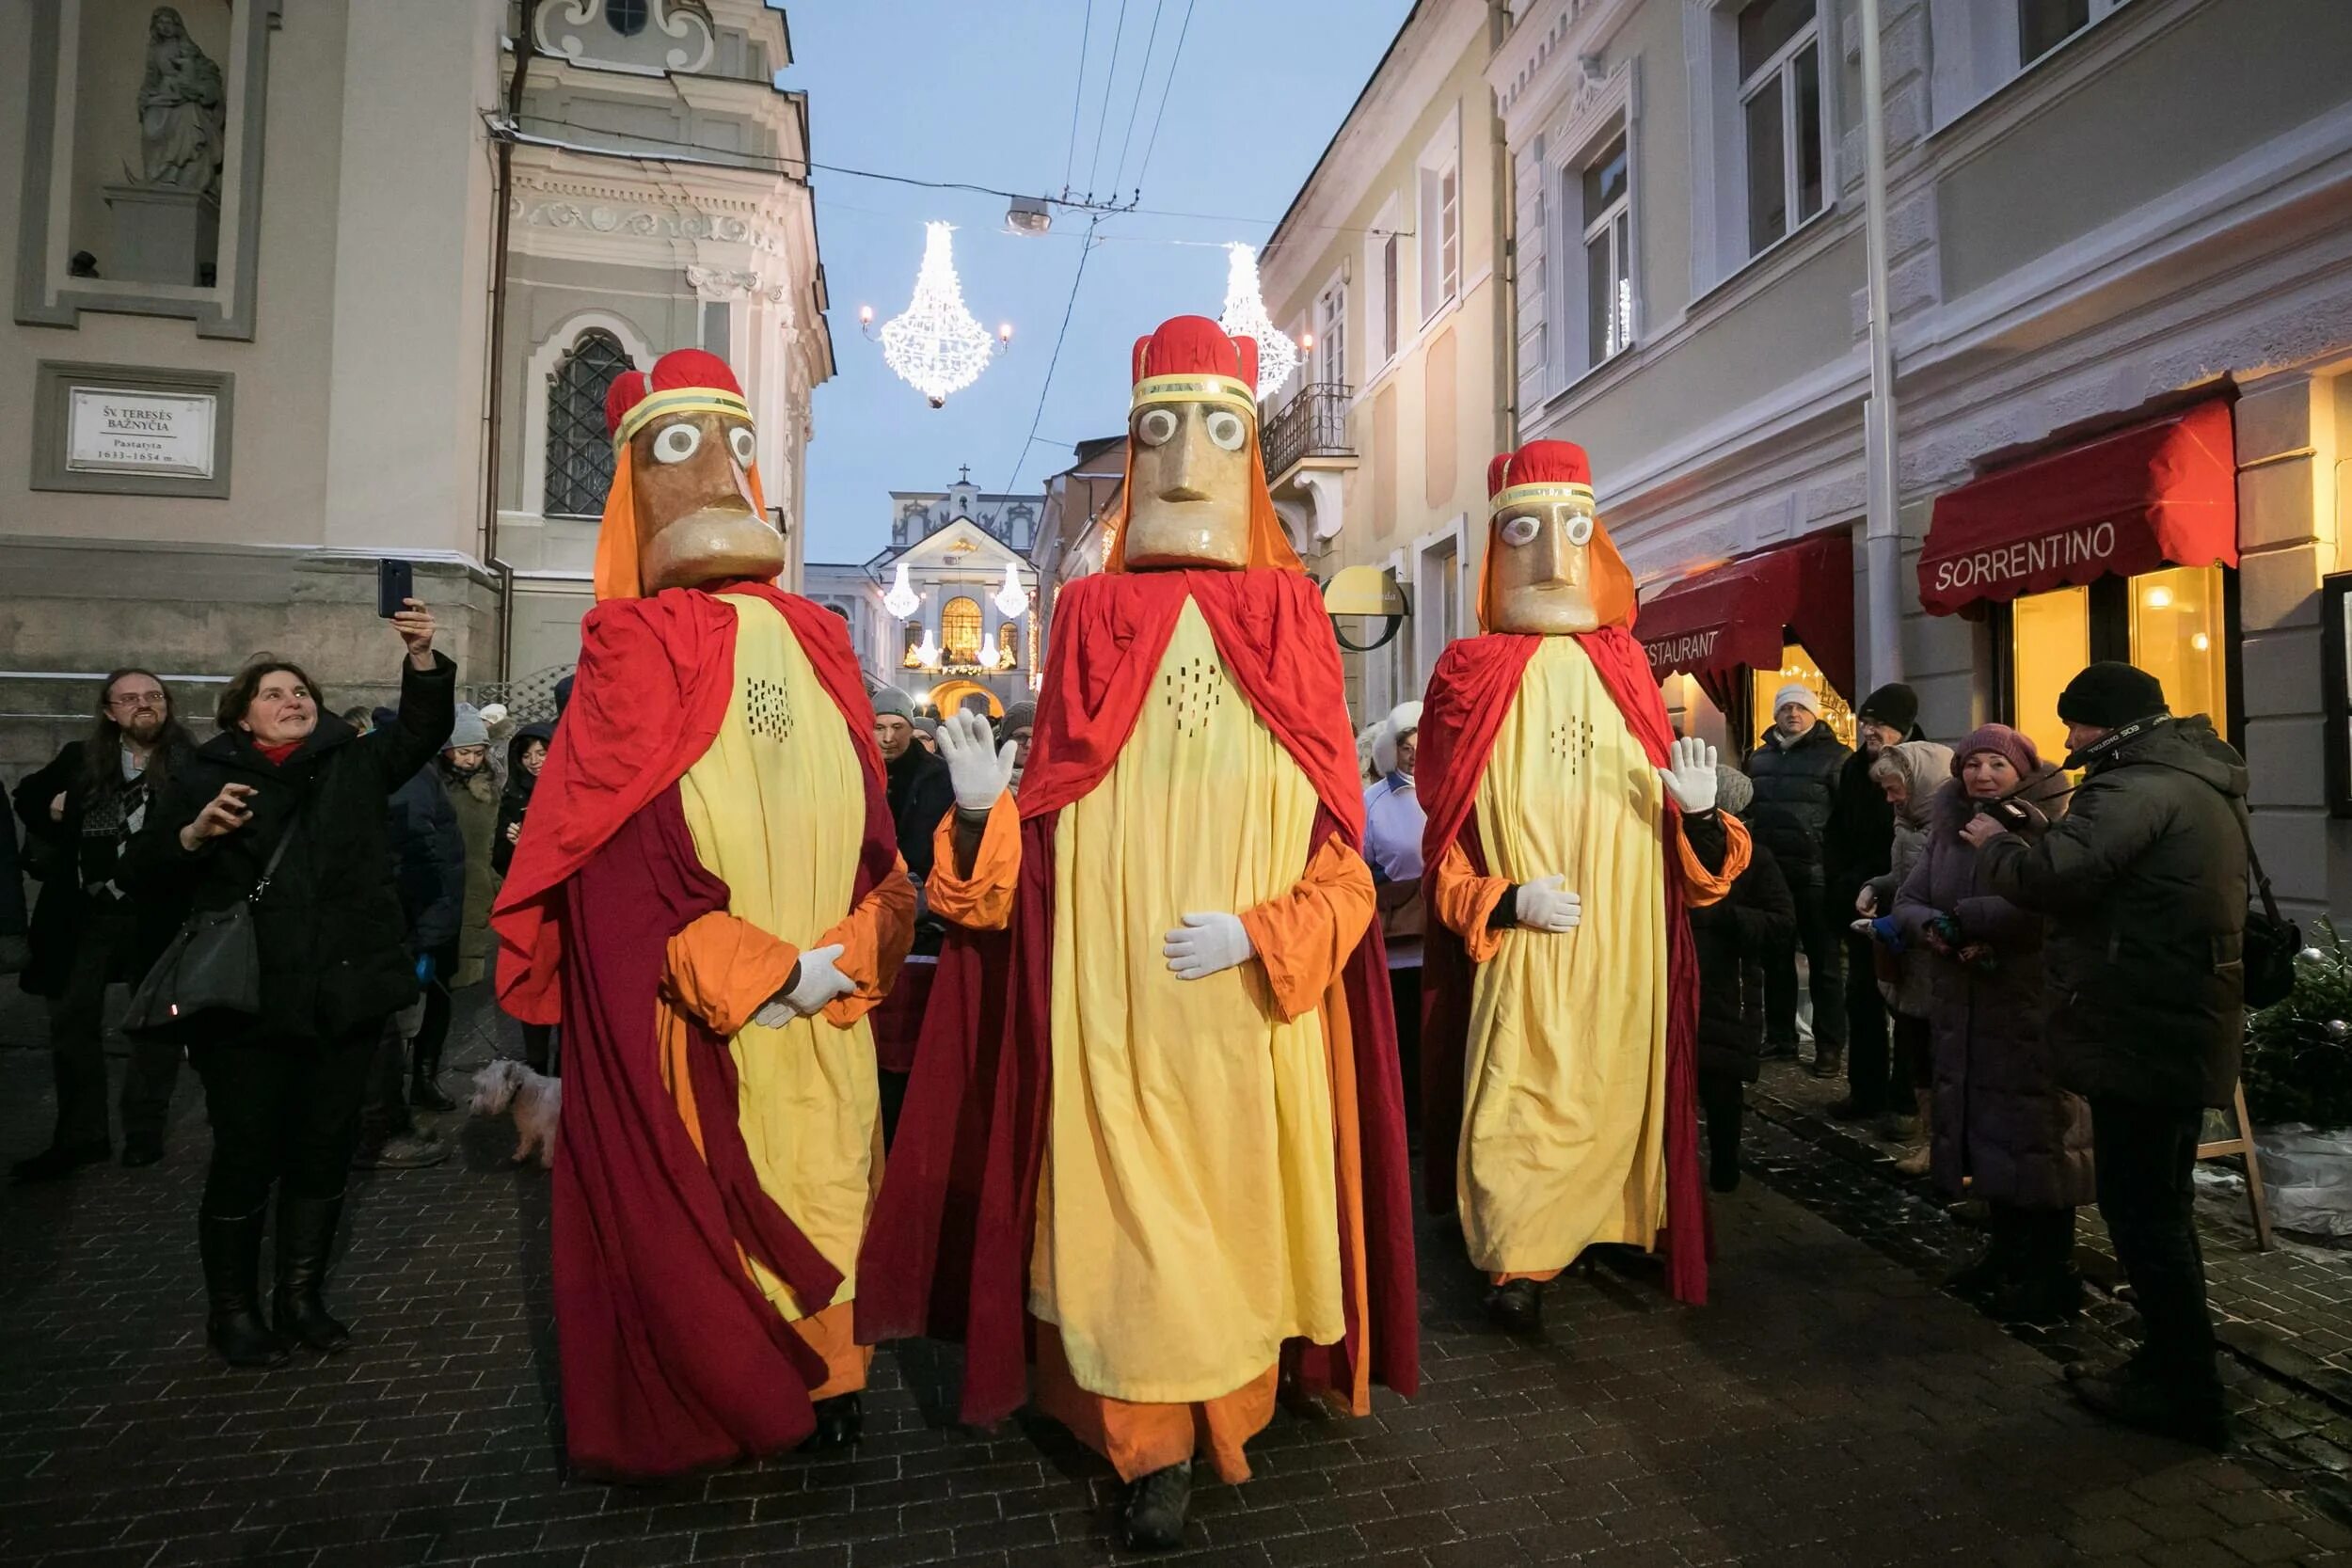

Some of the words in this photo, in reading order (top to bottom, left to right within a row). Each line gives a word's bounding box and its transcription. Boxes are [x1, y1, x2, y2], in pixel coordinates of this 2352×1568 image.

[120, 408, 173, 420] TERESĖS
[107, 417, 169, 432] BAŽNYČIA
[114, 438, 163, 451] Pastatyta
[1935, 522, 2115, 591] SORRENTINO
[1643, 630, 1719, 667] STAURANT
[2120, 724, 2140, 737] EOS
